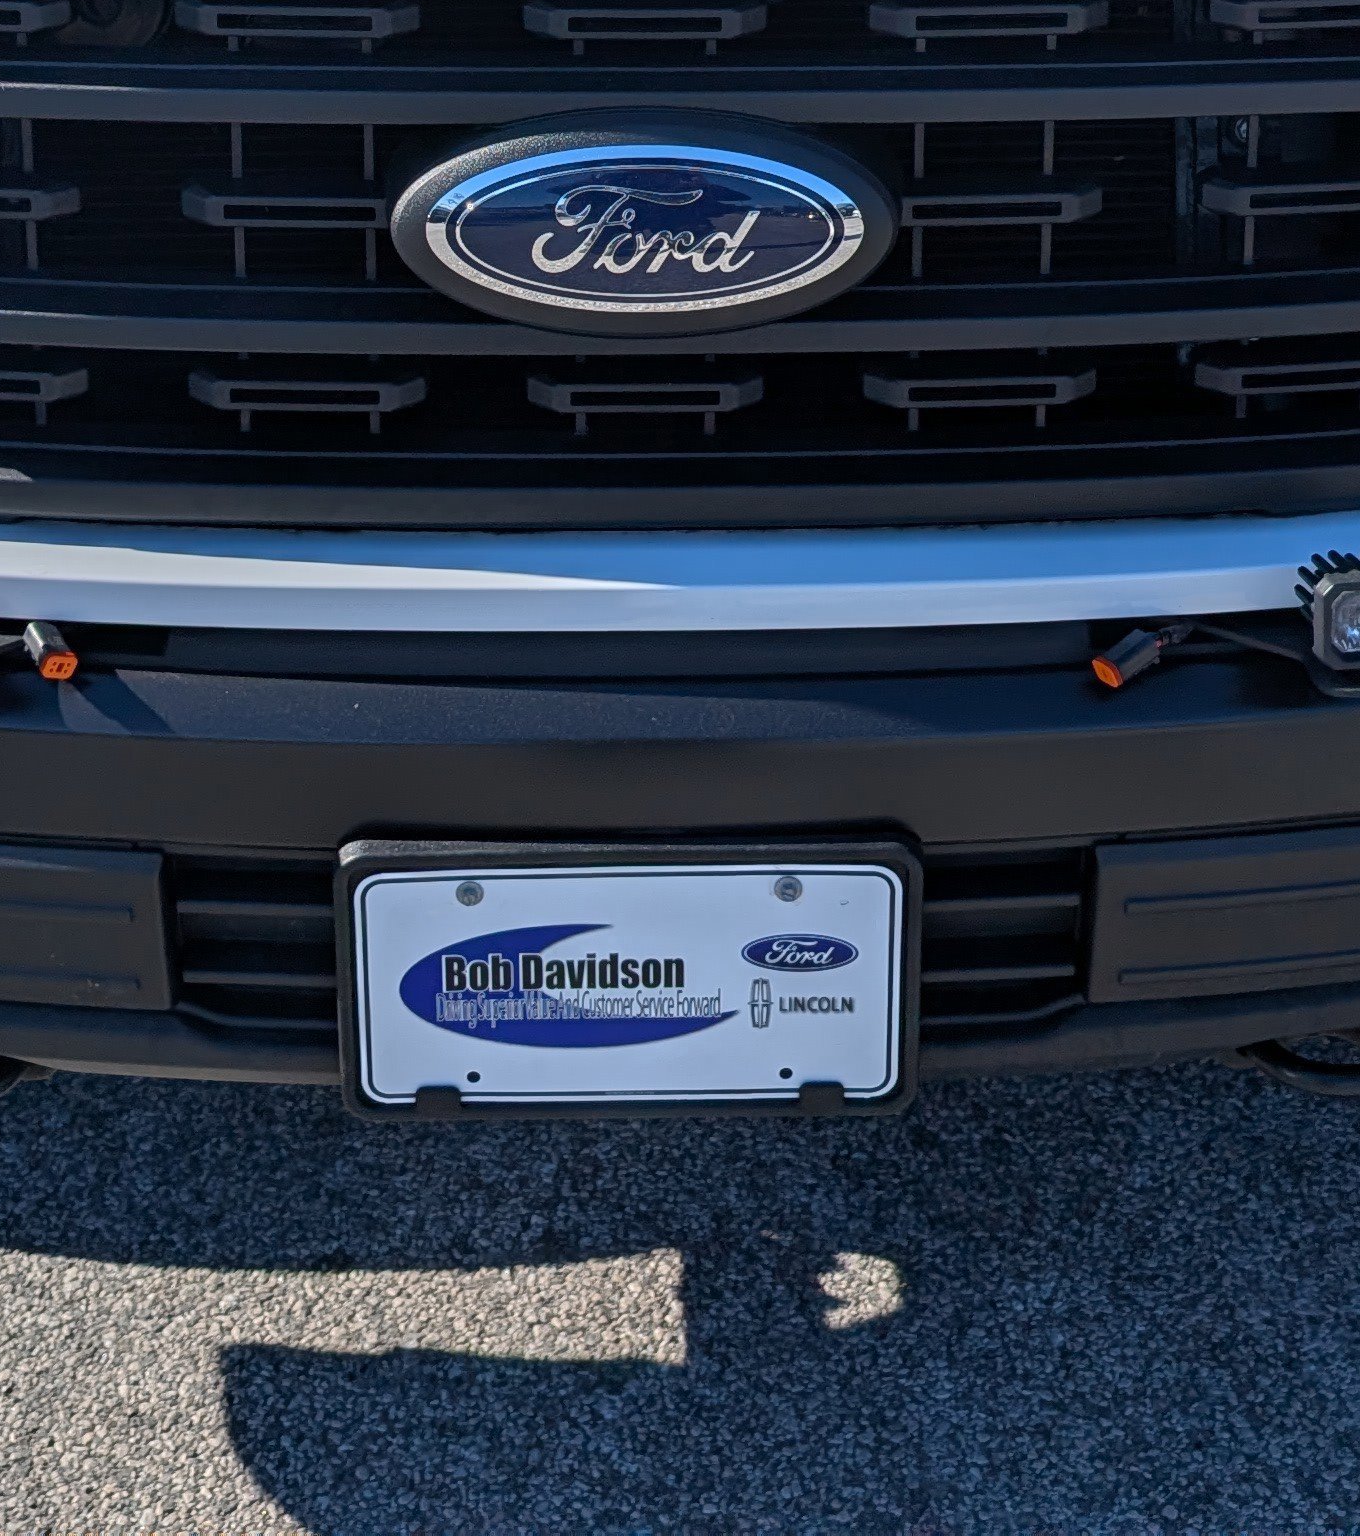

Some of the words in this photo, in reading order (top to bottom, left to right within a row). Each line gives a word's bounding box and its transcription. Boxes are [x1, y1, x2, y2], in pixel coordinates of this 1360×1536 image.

[531, 184, 760, 275] Ford
[765, 939, 835, 965] Ford
[442, 953, 514, 992] Bob
[518, 953, 686, 992] Davidson
[557, 989, 581, 1019] And
[581, 990, 635, 1019] Customer
[636, 989, 675, 1018] Service
[676, 987, 722, 1018] Forward
[779, 996, 854, 1014] LINCOLN
